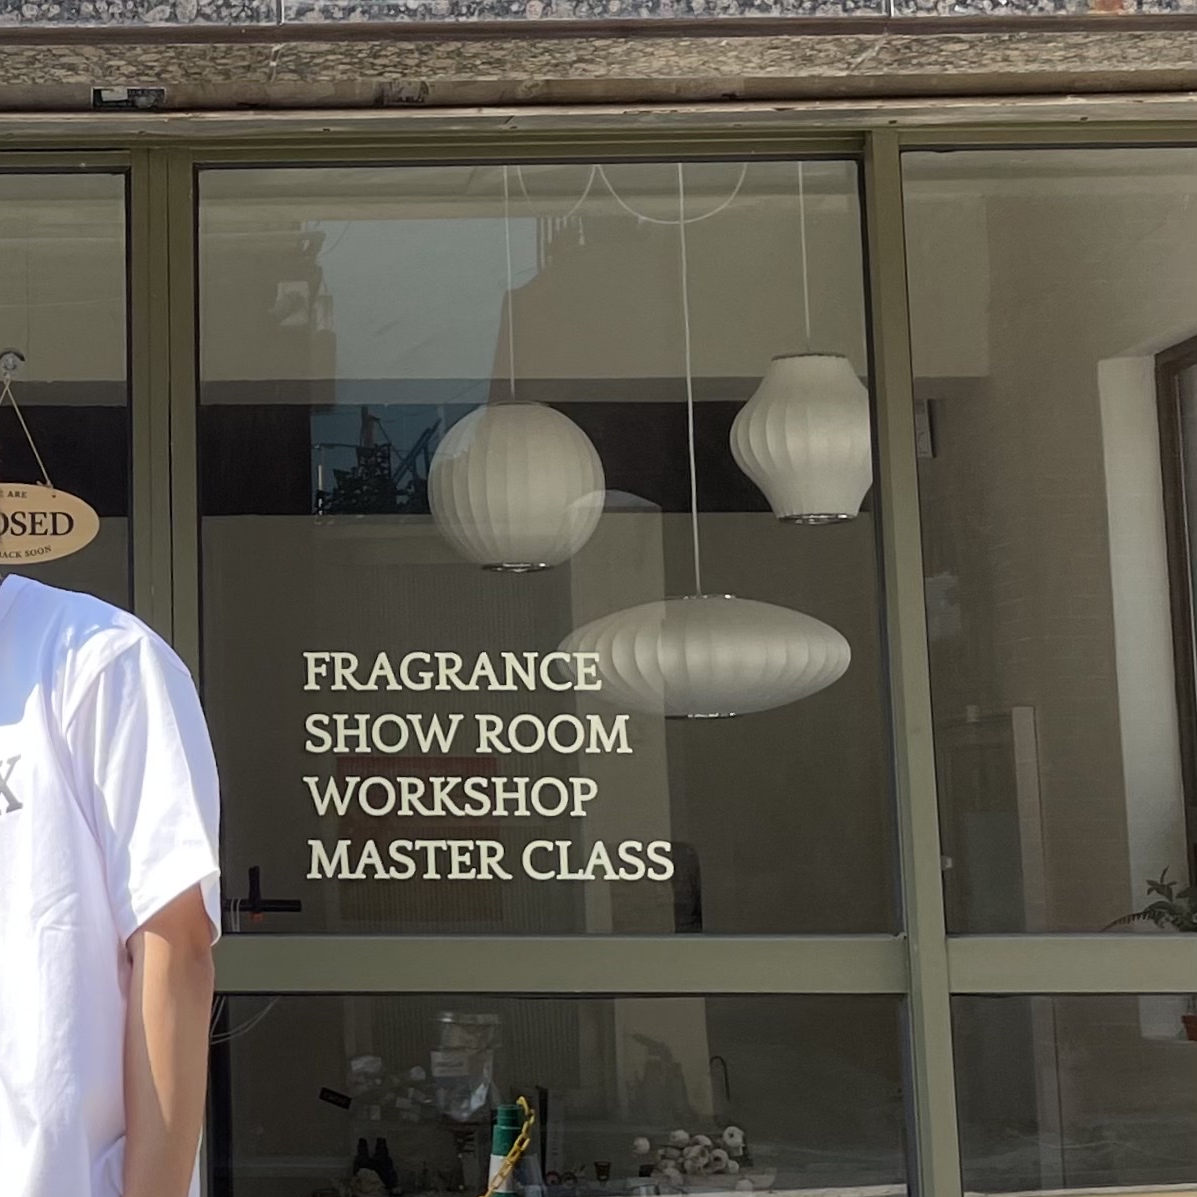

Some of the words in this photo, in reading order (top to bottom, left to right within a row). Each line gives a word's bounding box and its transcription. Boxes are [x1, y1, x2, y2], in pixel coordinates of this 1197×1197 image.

[7, 490, 27, 498] ARE
[24, 545, 52, 557] SOON
[303, 651, 603, 691] FRAGRANCE
[304, 713, 464, 754] SHOW
[474, 713, 633, 754] ROOM
[303, 776, 599, 817] WORKSHOP
[306, 839, 513, 881] MASTER
[521, 840, 675, 881] CLASS
